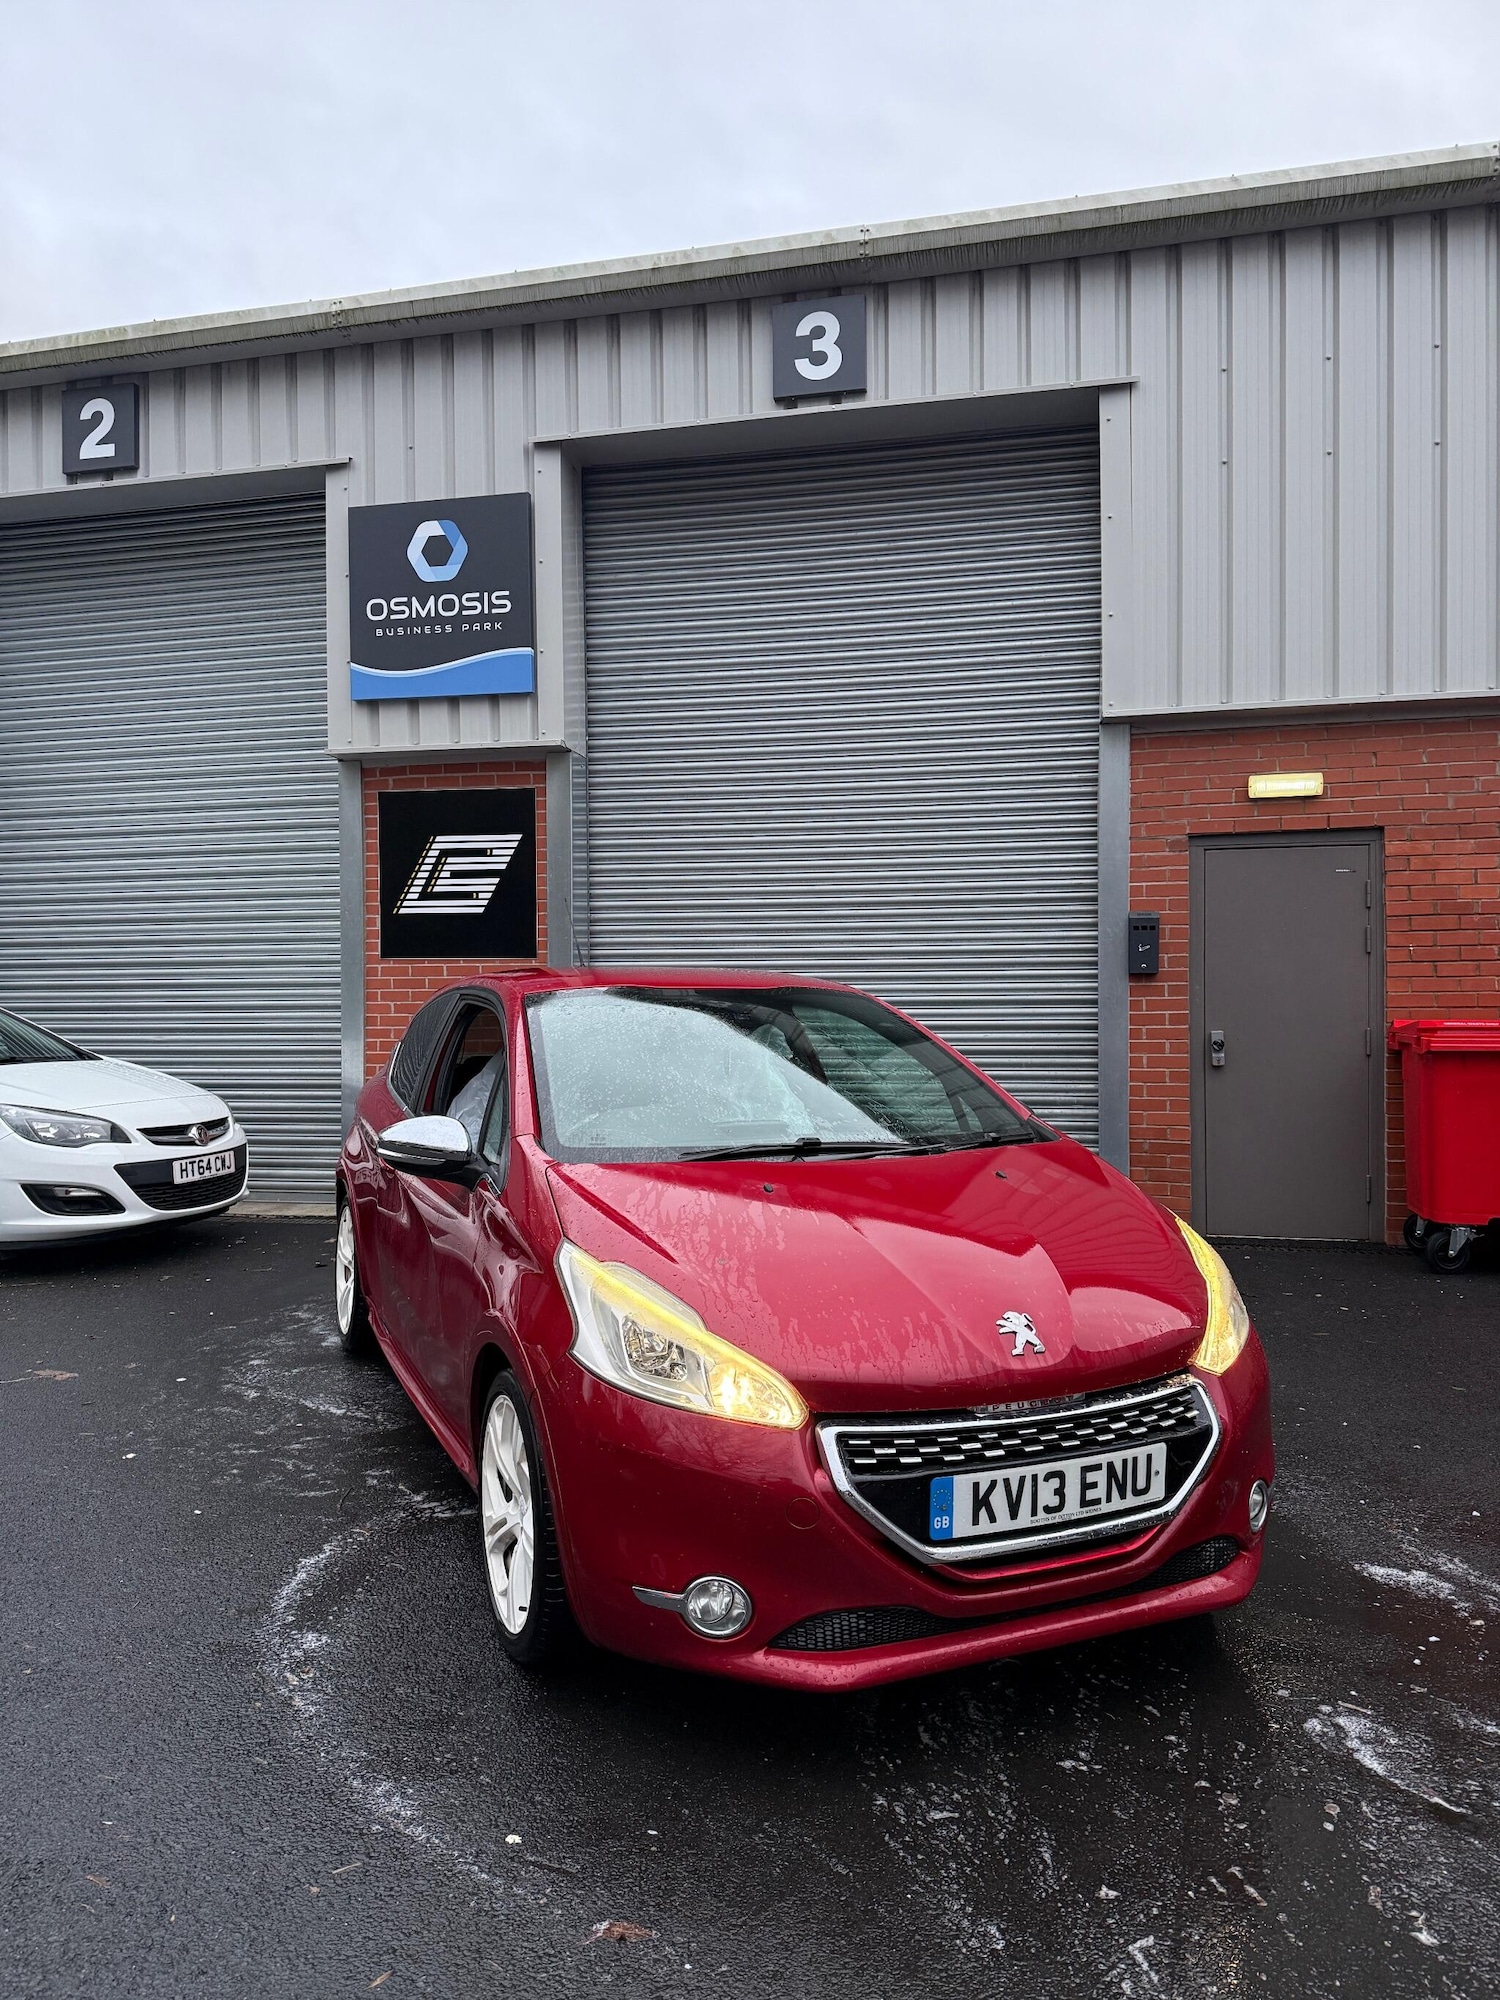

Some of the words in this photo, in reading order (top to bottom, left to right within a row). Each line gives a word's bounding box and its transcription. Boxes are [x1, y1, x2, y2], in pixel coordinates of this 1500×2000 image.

[794, 311, 843, 381] 3
[80, 397, 115, 460] 2
[366, 590, 512, 621] OSMOSIS
[375, 624, 453, 637] BUSINESS
[461, 621, 503, 632] PARK
[180, 1158, 212, 1179] HT64
[971, 1469, 1067, 1527] KV13
[1079, 1453, 1153, 1509] ENU
[933, 1515, 950, 1530] GB
